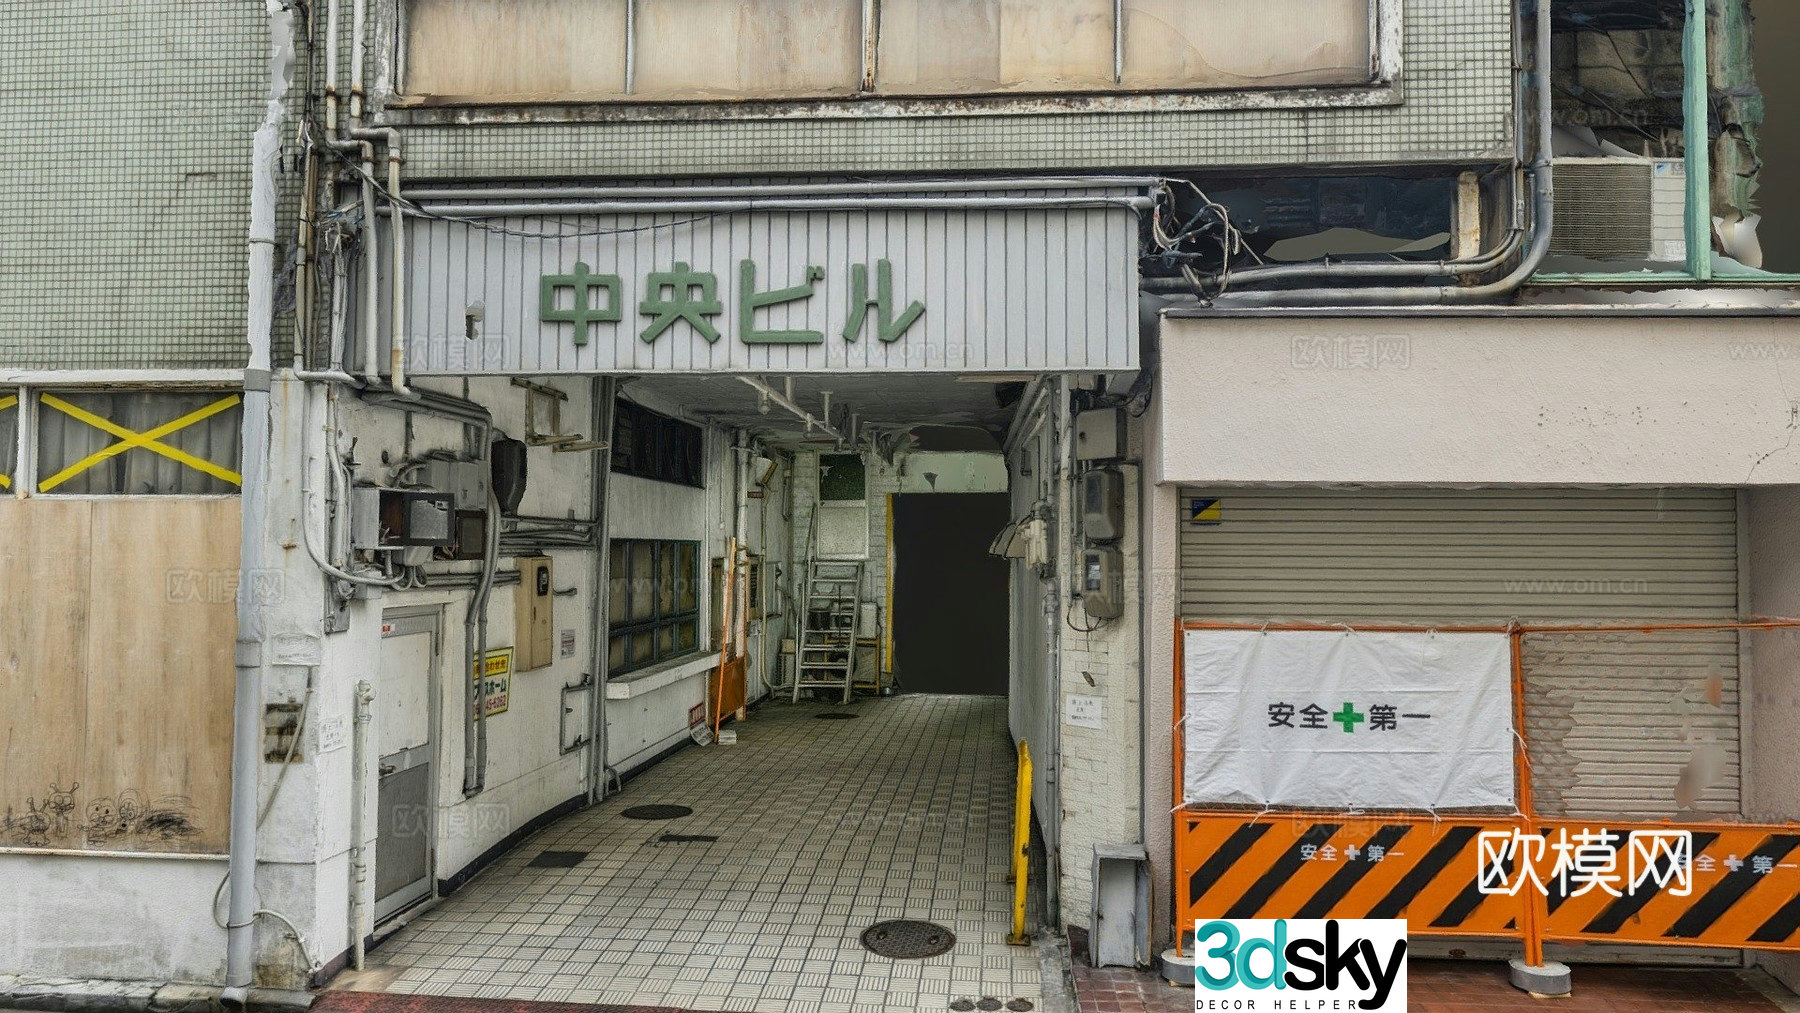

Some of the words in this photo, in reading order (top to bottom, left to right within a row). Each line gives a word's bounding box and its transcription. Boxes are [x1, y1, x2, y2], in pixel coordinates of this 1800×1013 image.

[540, 259, 925, 346] 中央ビル
[1268, 702, 1328, 729] 安全
[1369, 704, 1431, 731] 第一
[1300, 843, 1337, 862] 安全
[1367, 844, 1404, 862] 第一
[1752, 855, 1797, 874] 第一
